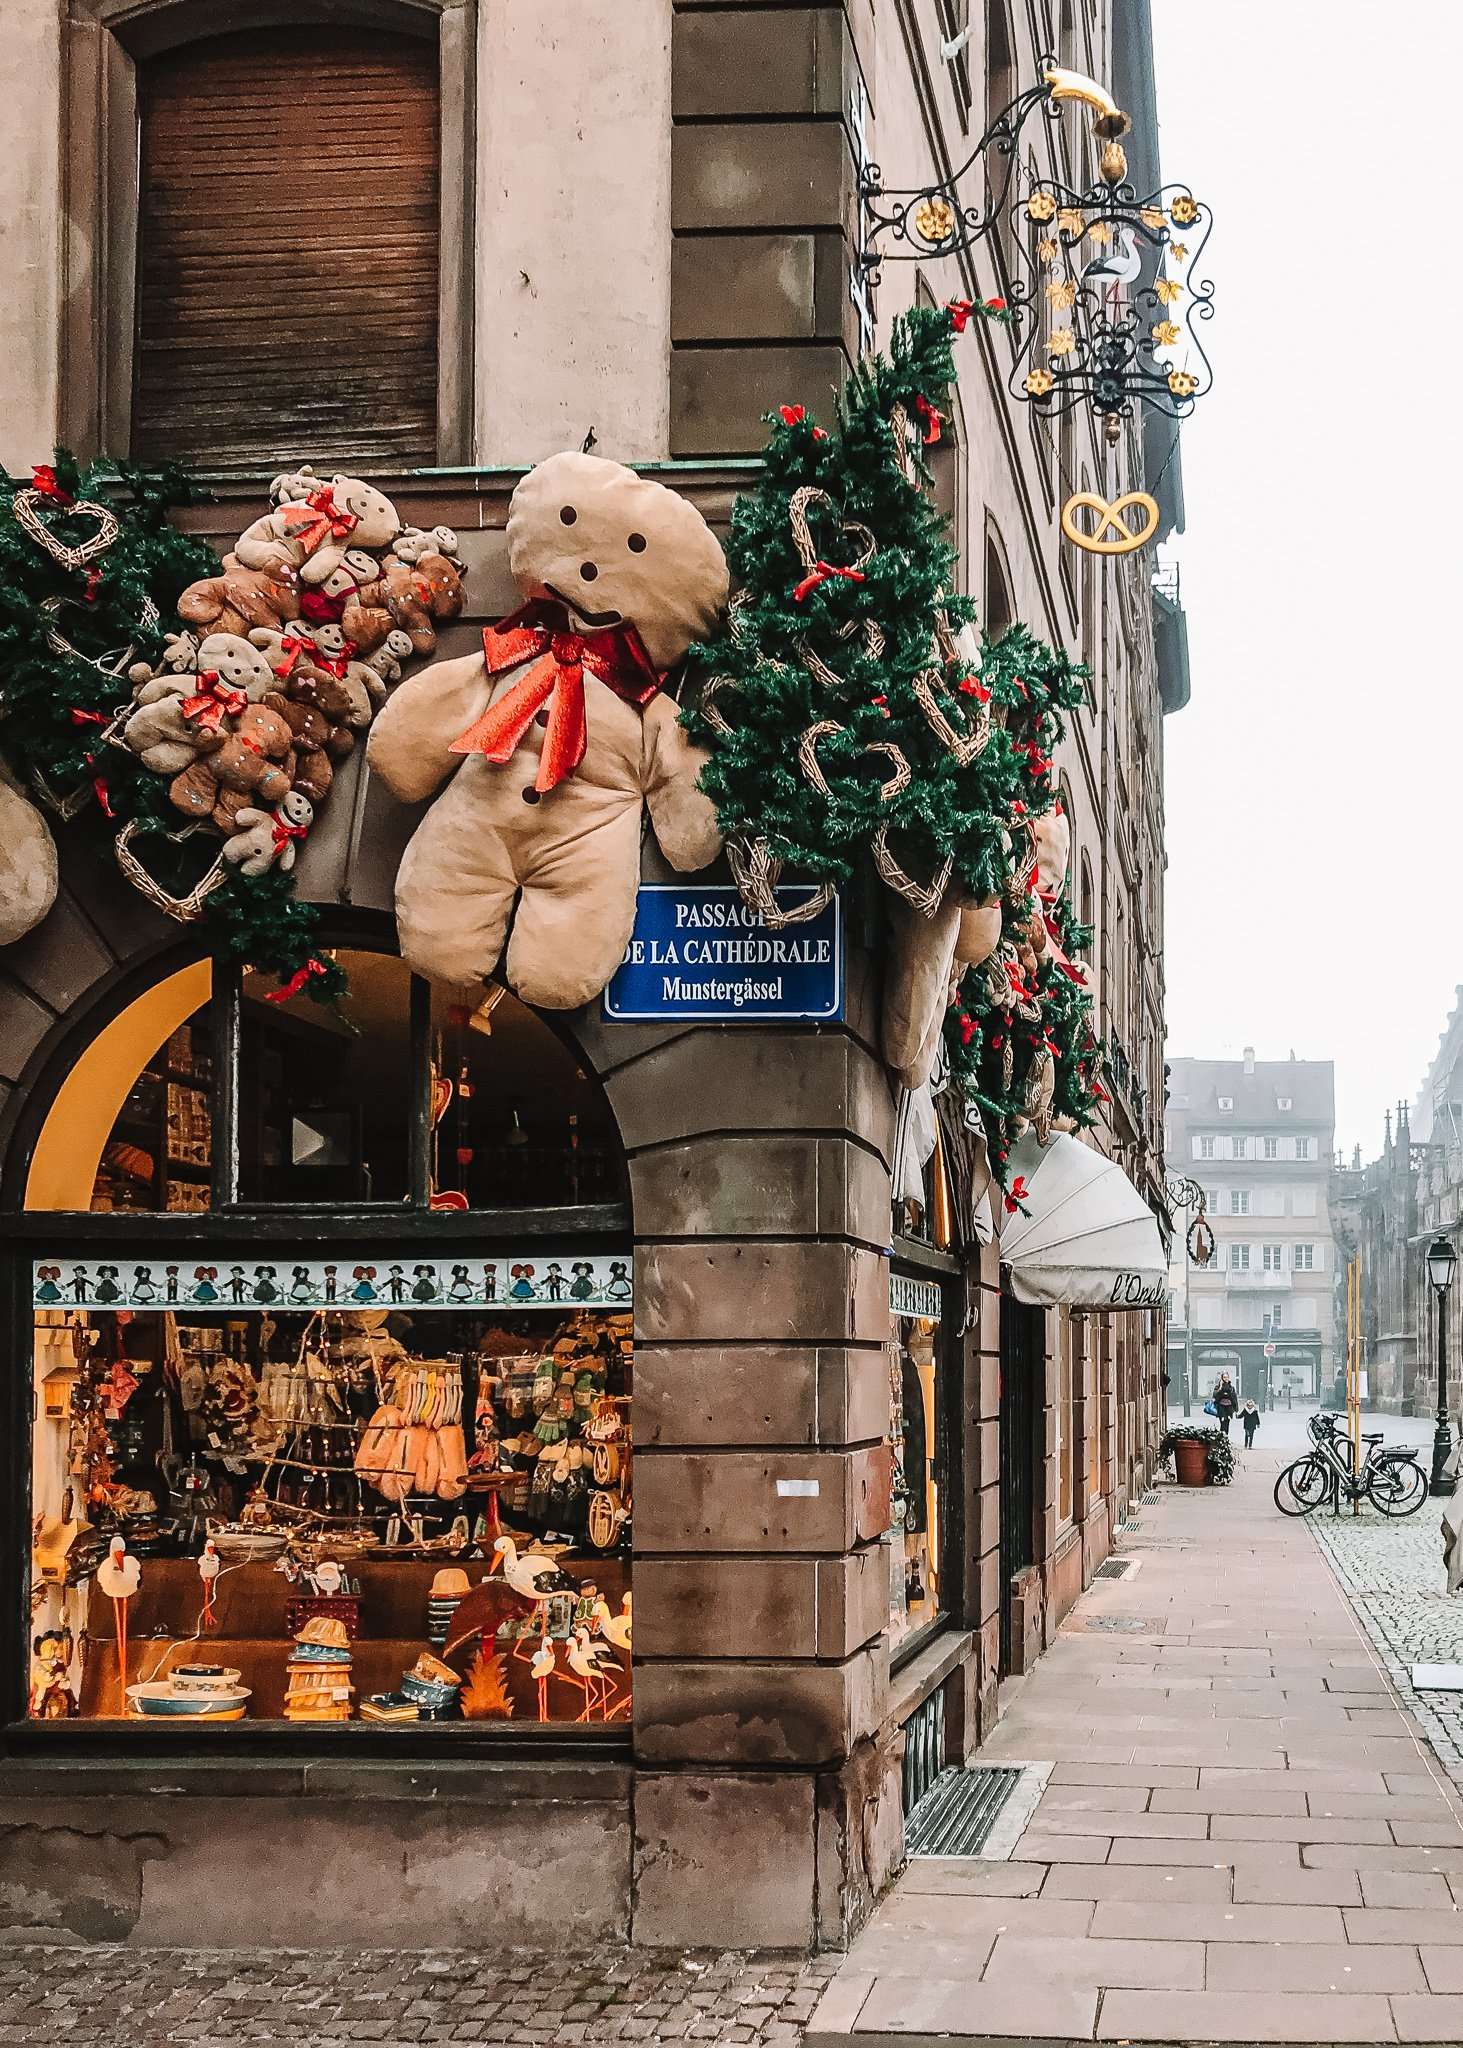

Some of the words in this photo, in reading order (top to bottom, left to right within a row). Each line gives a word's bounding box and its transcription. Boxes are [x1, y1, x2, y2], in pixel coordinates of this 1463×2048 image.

[650, 940, 680, 964] LA
[684, 933, 830, 964] CATHÉDRALE
[662, 976, 783, 1006] Munstergässel
